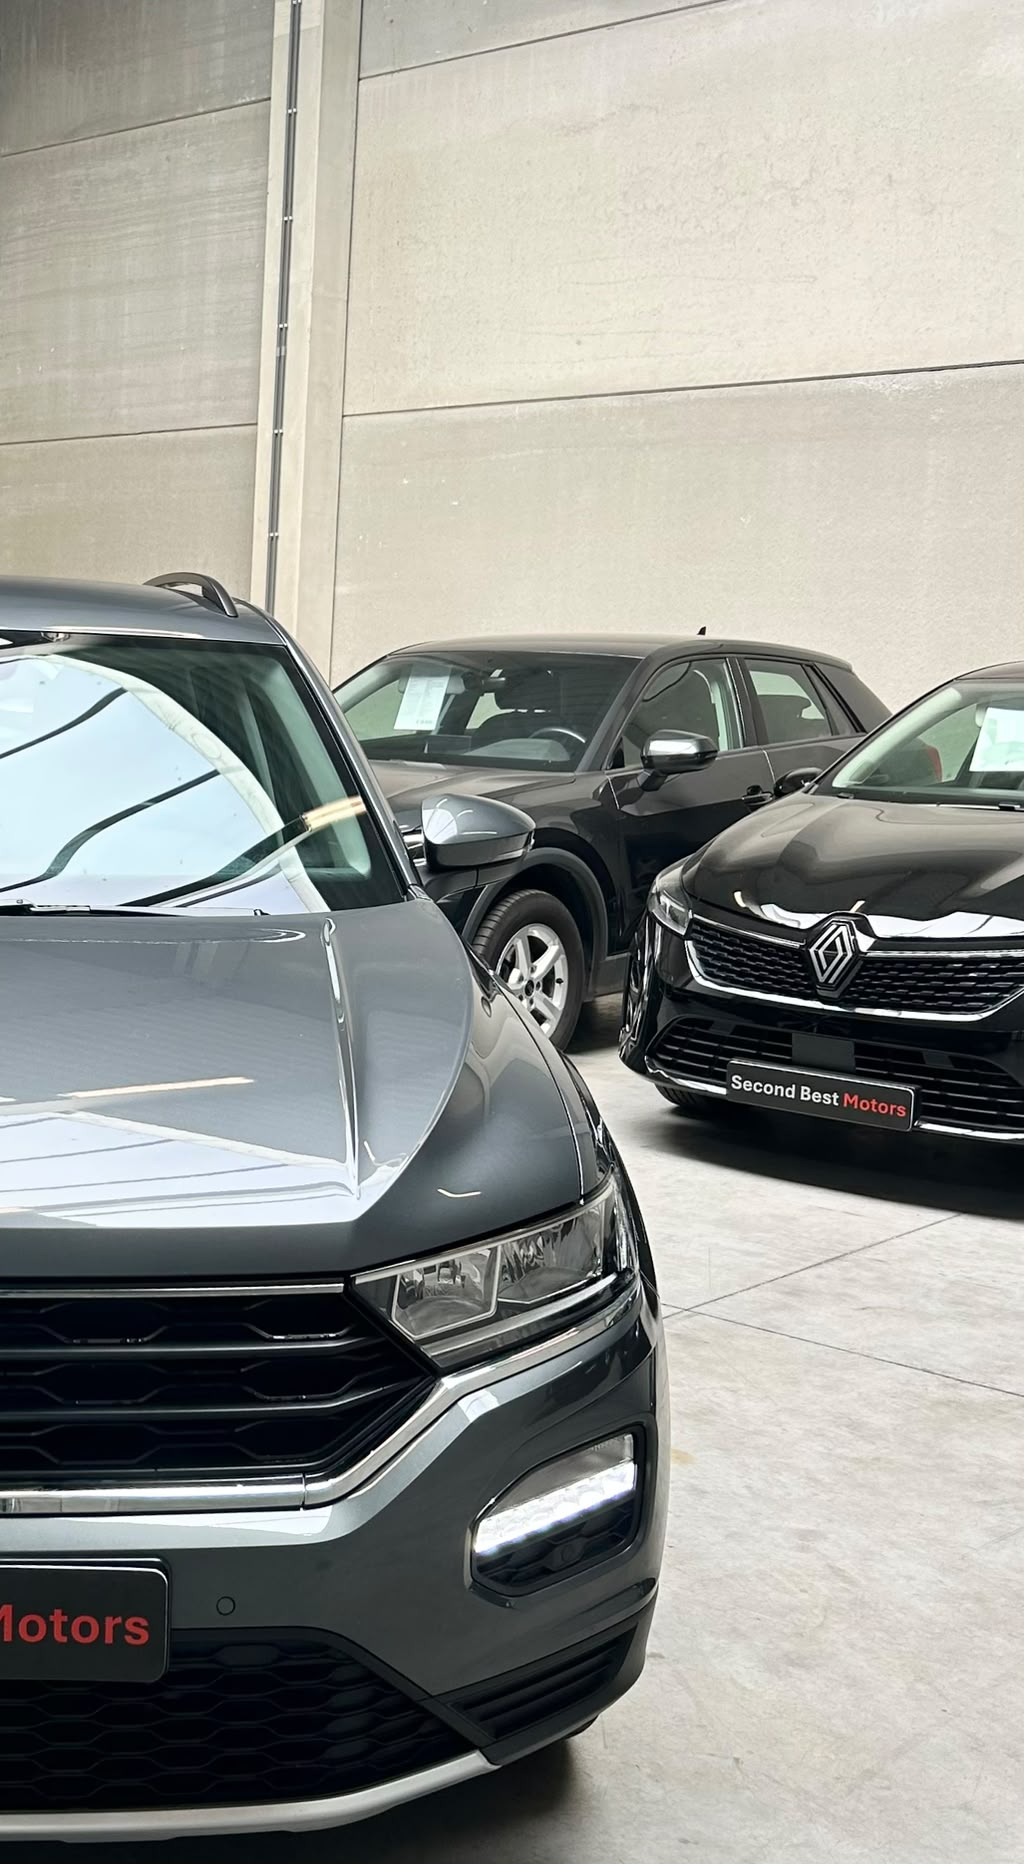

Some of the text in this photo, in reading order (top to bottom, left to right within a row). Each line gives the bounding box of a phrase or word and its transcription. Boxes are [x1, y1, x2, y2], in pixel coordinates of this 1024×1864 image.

[731, 1075, 906, 1117] Second Best Motors
